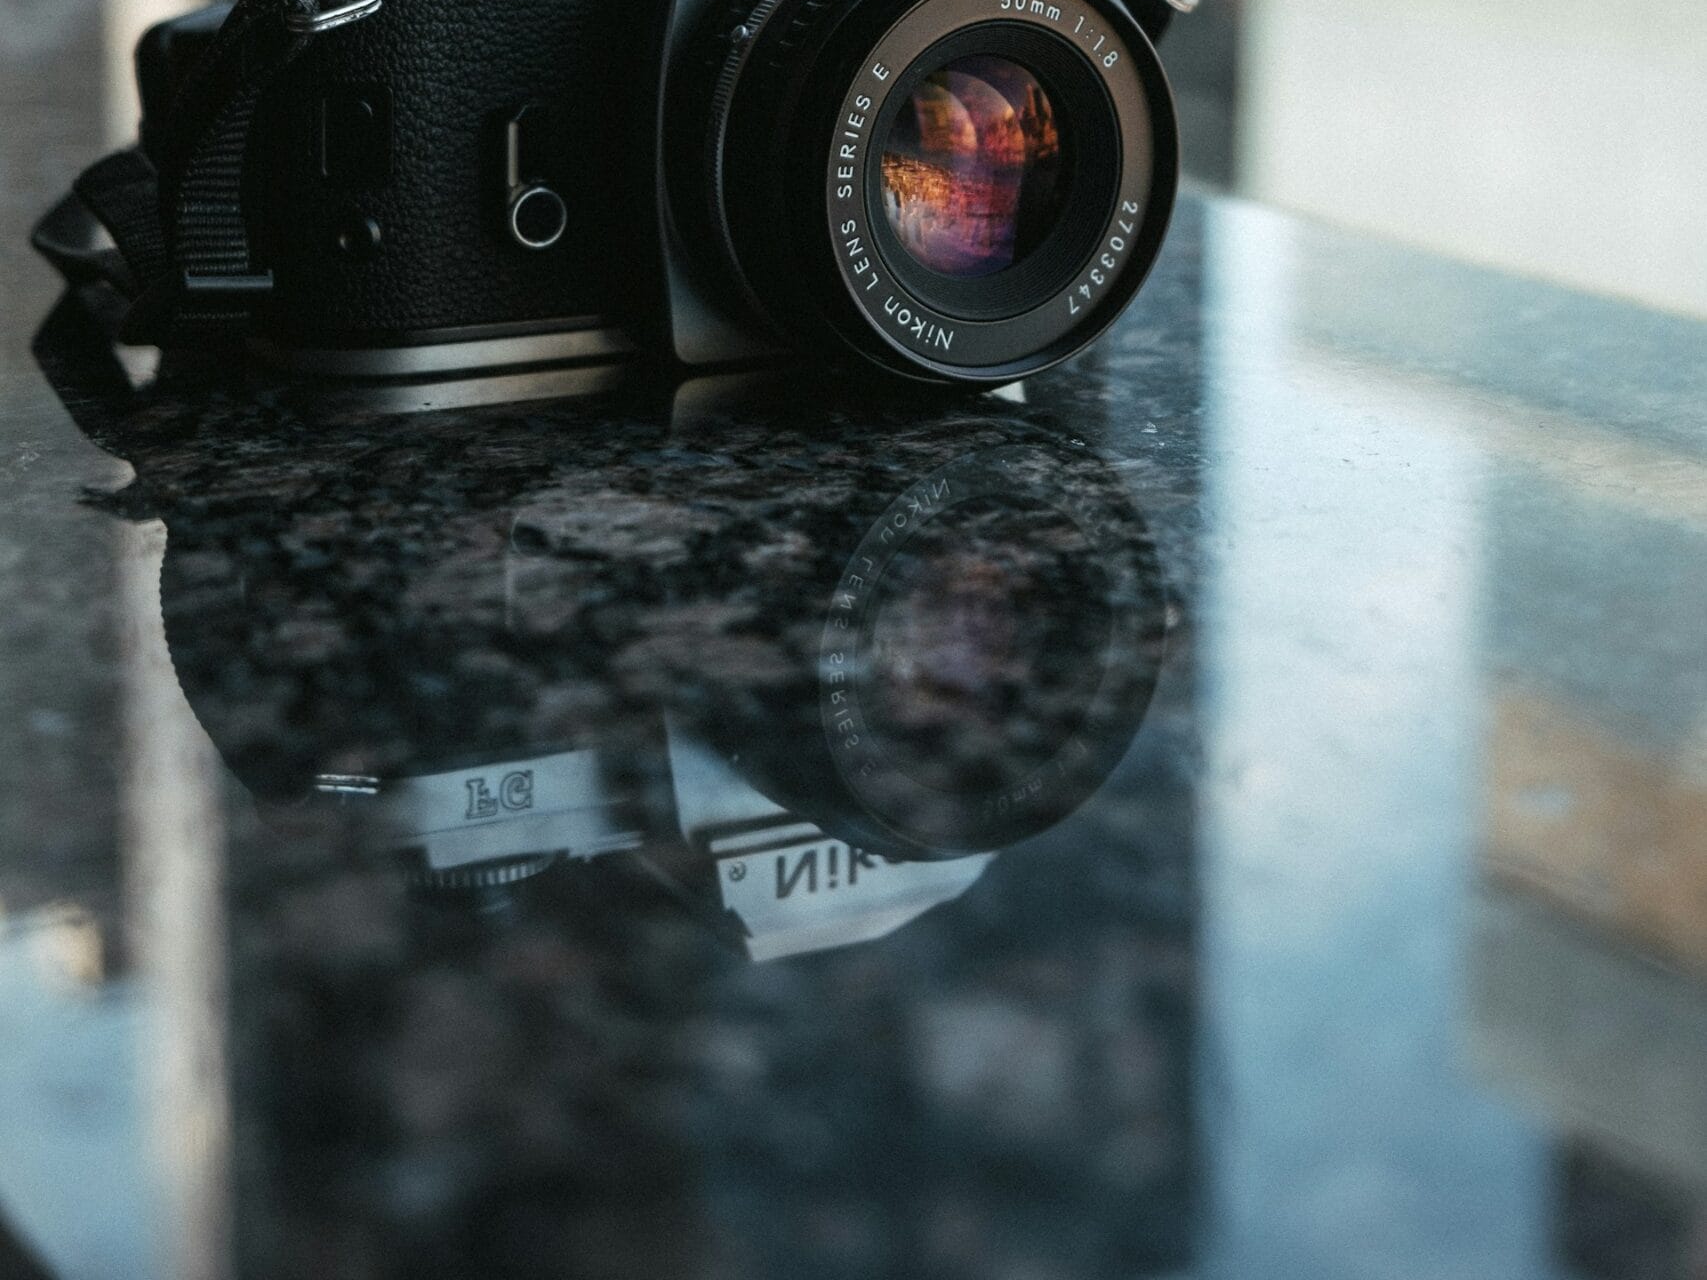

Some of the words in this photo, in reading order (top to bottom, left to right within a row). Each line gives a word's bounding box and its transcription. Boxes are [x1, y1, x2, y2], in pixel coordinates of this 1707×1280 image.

[872, 61, 890, 81] E
[1074, 15, 1120, 69] 1:1.8
[837, 94, 871, 199] SERIES
[841, 219, 879, 291] LENS
[1067, 201, 1139, 316] 2703347
[884, 294, 954, 350] Nikon
